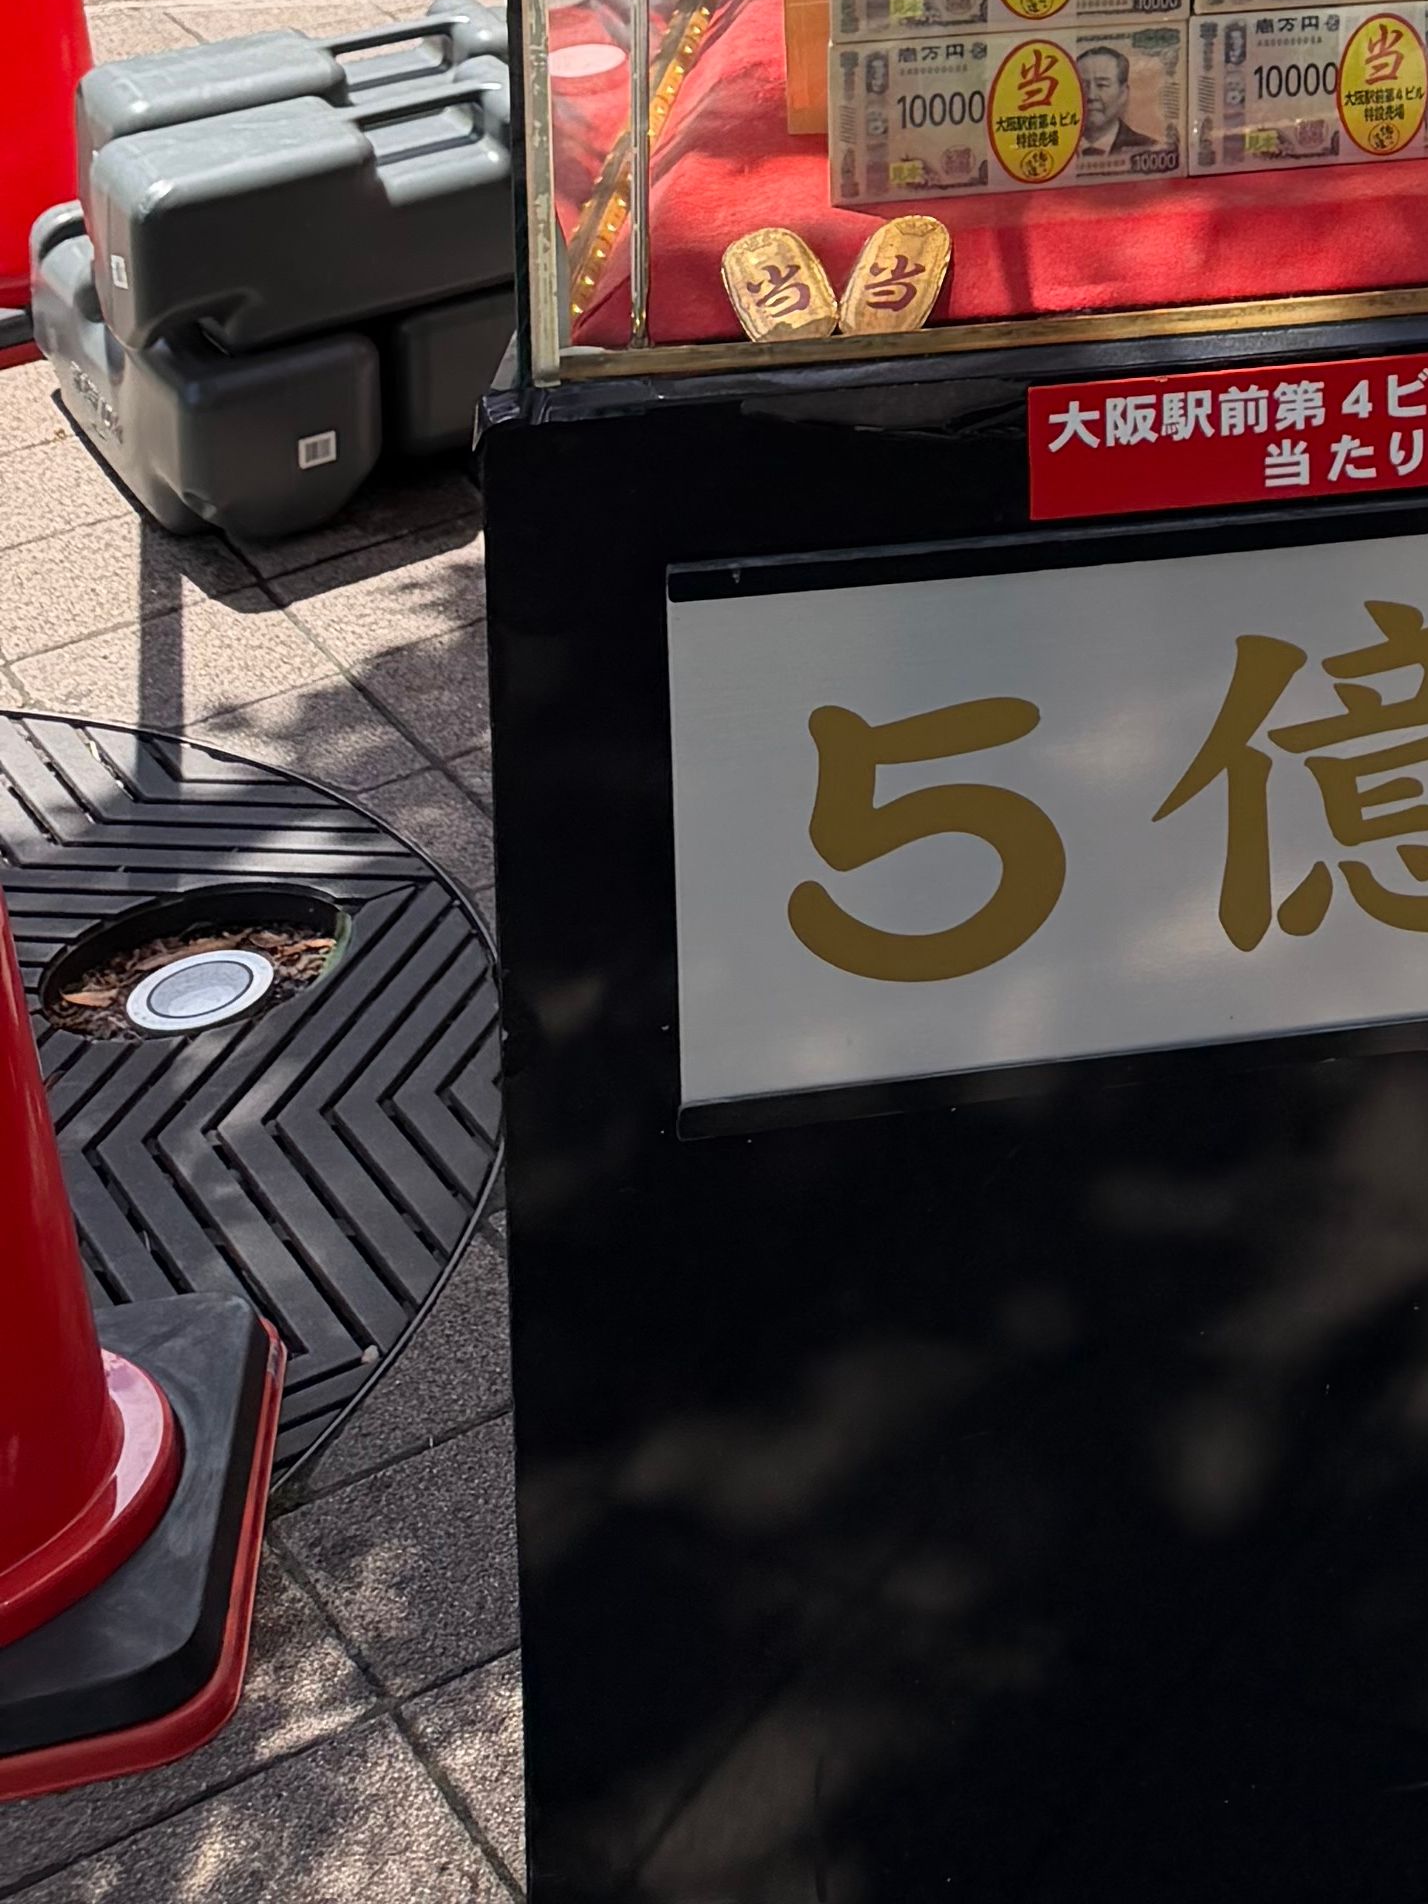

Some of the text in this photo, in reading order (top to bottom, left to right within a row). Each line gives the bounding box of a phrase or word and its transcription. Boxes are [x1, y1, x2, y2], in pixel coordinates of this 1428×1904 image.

[1017, 49, 1059, 111] 当
[1254, 62, 1338, 99] 10000
[1365, 24, 1404, 84] 当
[898, 91, 985, 129] 10000
[747, 265, 811, 318] 当
[864, 255, 926, 311] 当
